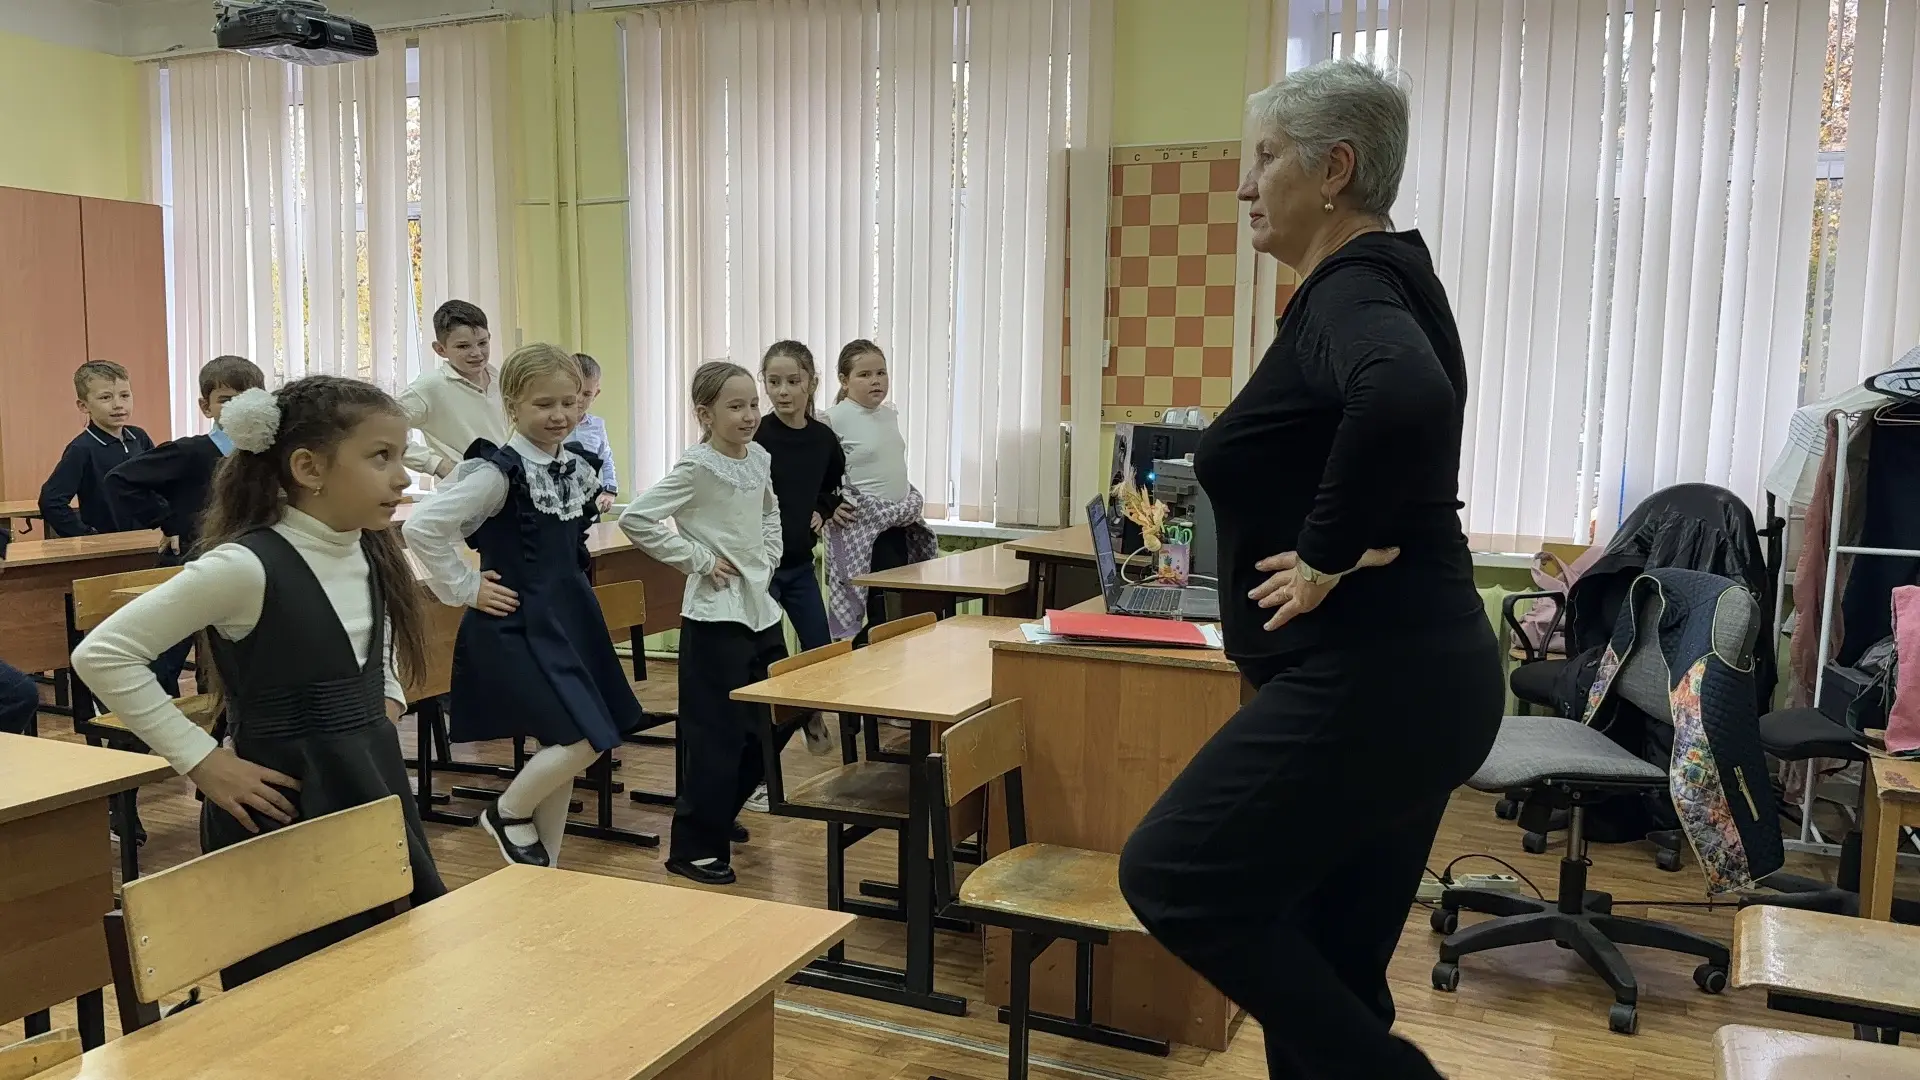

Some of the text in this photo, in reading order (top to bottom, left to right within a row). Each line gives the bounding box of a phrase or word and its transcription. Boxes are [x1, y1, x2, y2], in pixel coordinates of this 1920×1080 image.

[1134, 153, 1140, 161] C
[1163, 152, 1169, 160] D
[1223, 149, 1228, 157] F
[1155, 410, 1160, 418] D
